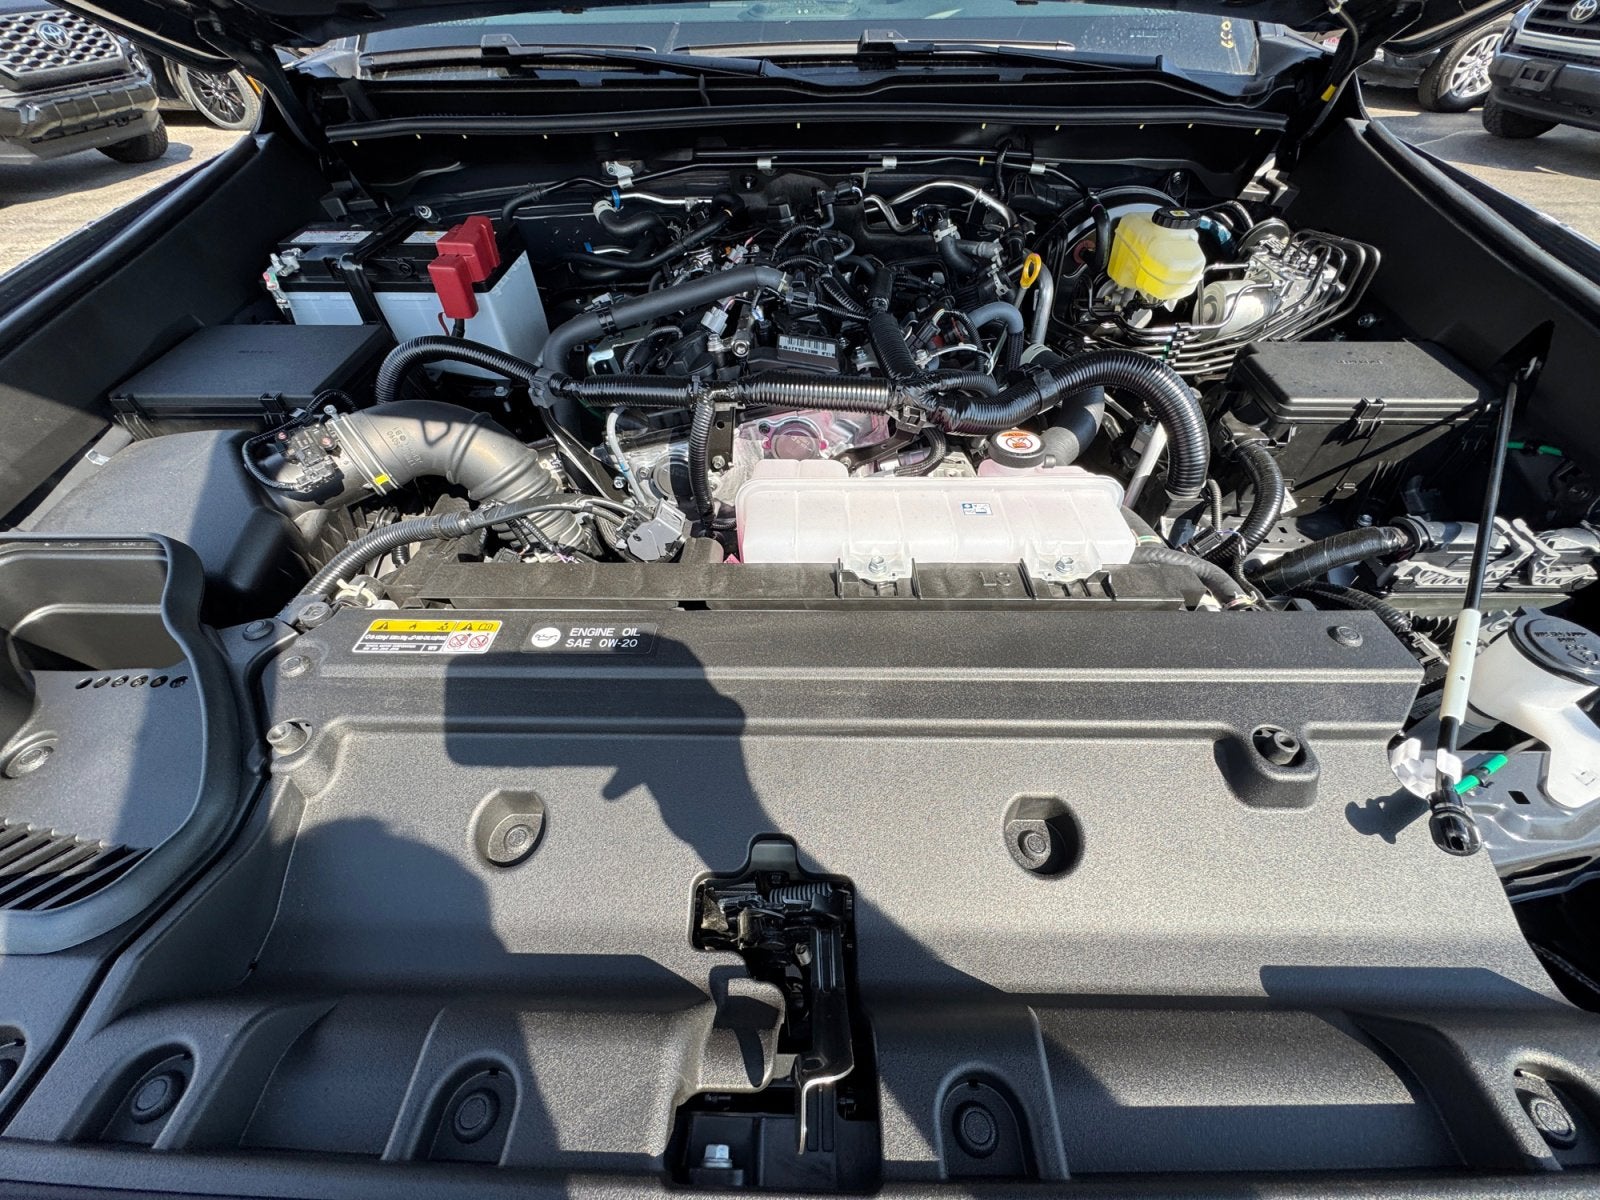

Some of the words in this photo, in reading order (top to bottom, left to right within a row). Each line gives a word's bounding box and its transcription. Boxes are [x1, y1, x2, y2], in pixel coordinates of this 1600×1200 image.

[569, 627, 616, 637] ENGINE
[621, 627, 641, 637] OIL
[565, 638, 592, 648] SAE
[598, 638, 638, 648] 0W-20
